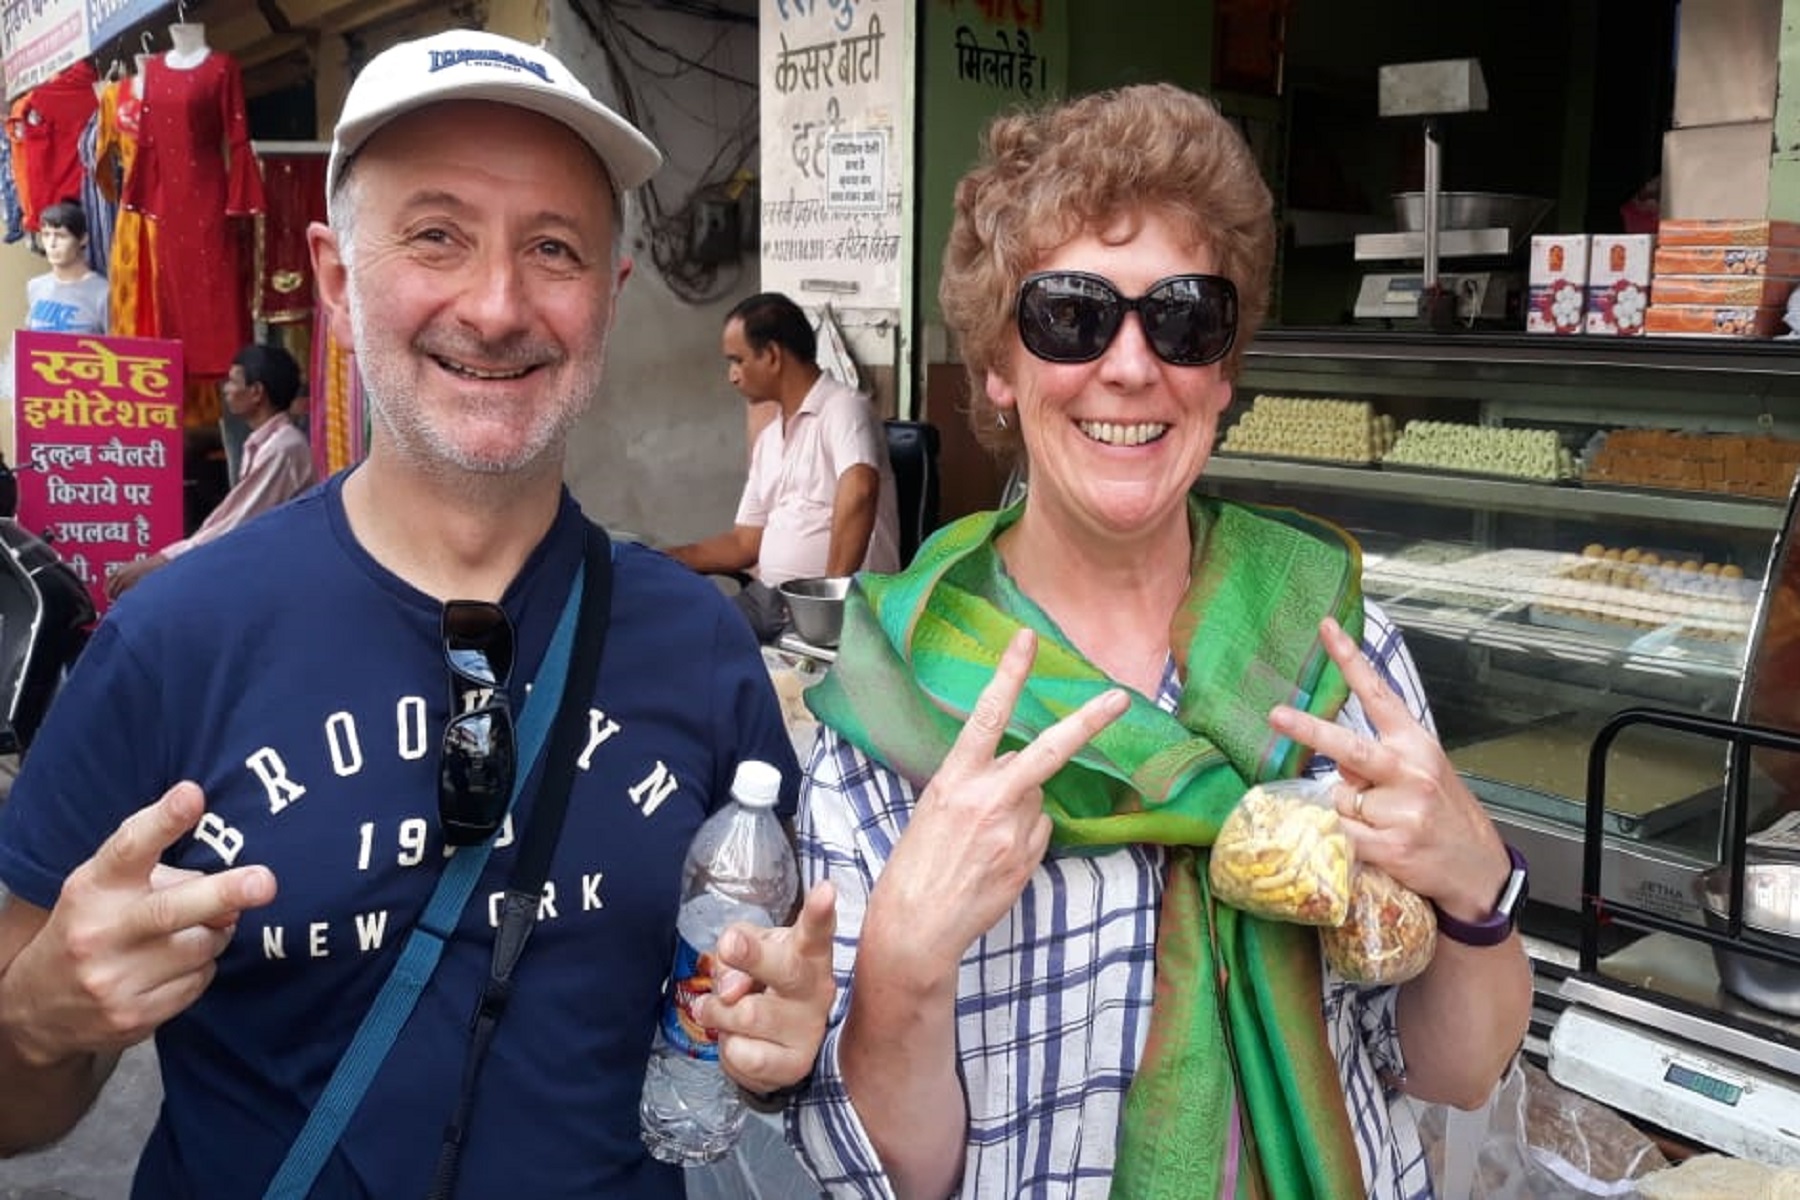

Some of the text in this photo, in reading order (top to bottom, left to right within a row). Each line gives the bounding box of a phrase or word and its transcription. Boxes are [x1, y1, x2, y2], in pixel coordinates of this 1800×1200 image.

[955, 26, 1016, 88] मिलते
[32, 299, 80, 323] NIKE
[31, 340, 171, 398] स्नेह
[23, 389, 177, 429] इमीटेशन
[31, 437, 166, 472] दुल्हन ज्वैलरी
[47, 477, 152, 505] किराये पर
[136, 514, 151, 546] है
[194, 683, 679, 866] BROOYN
[357, 812, 515, 871] 19
[263, 873, 603, 959] NEW ORK
